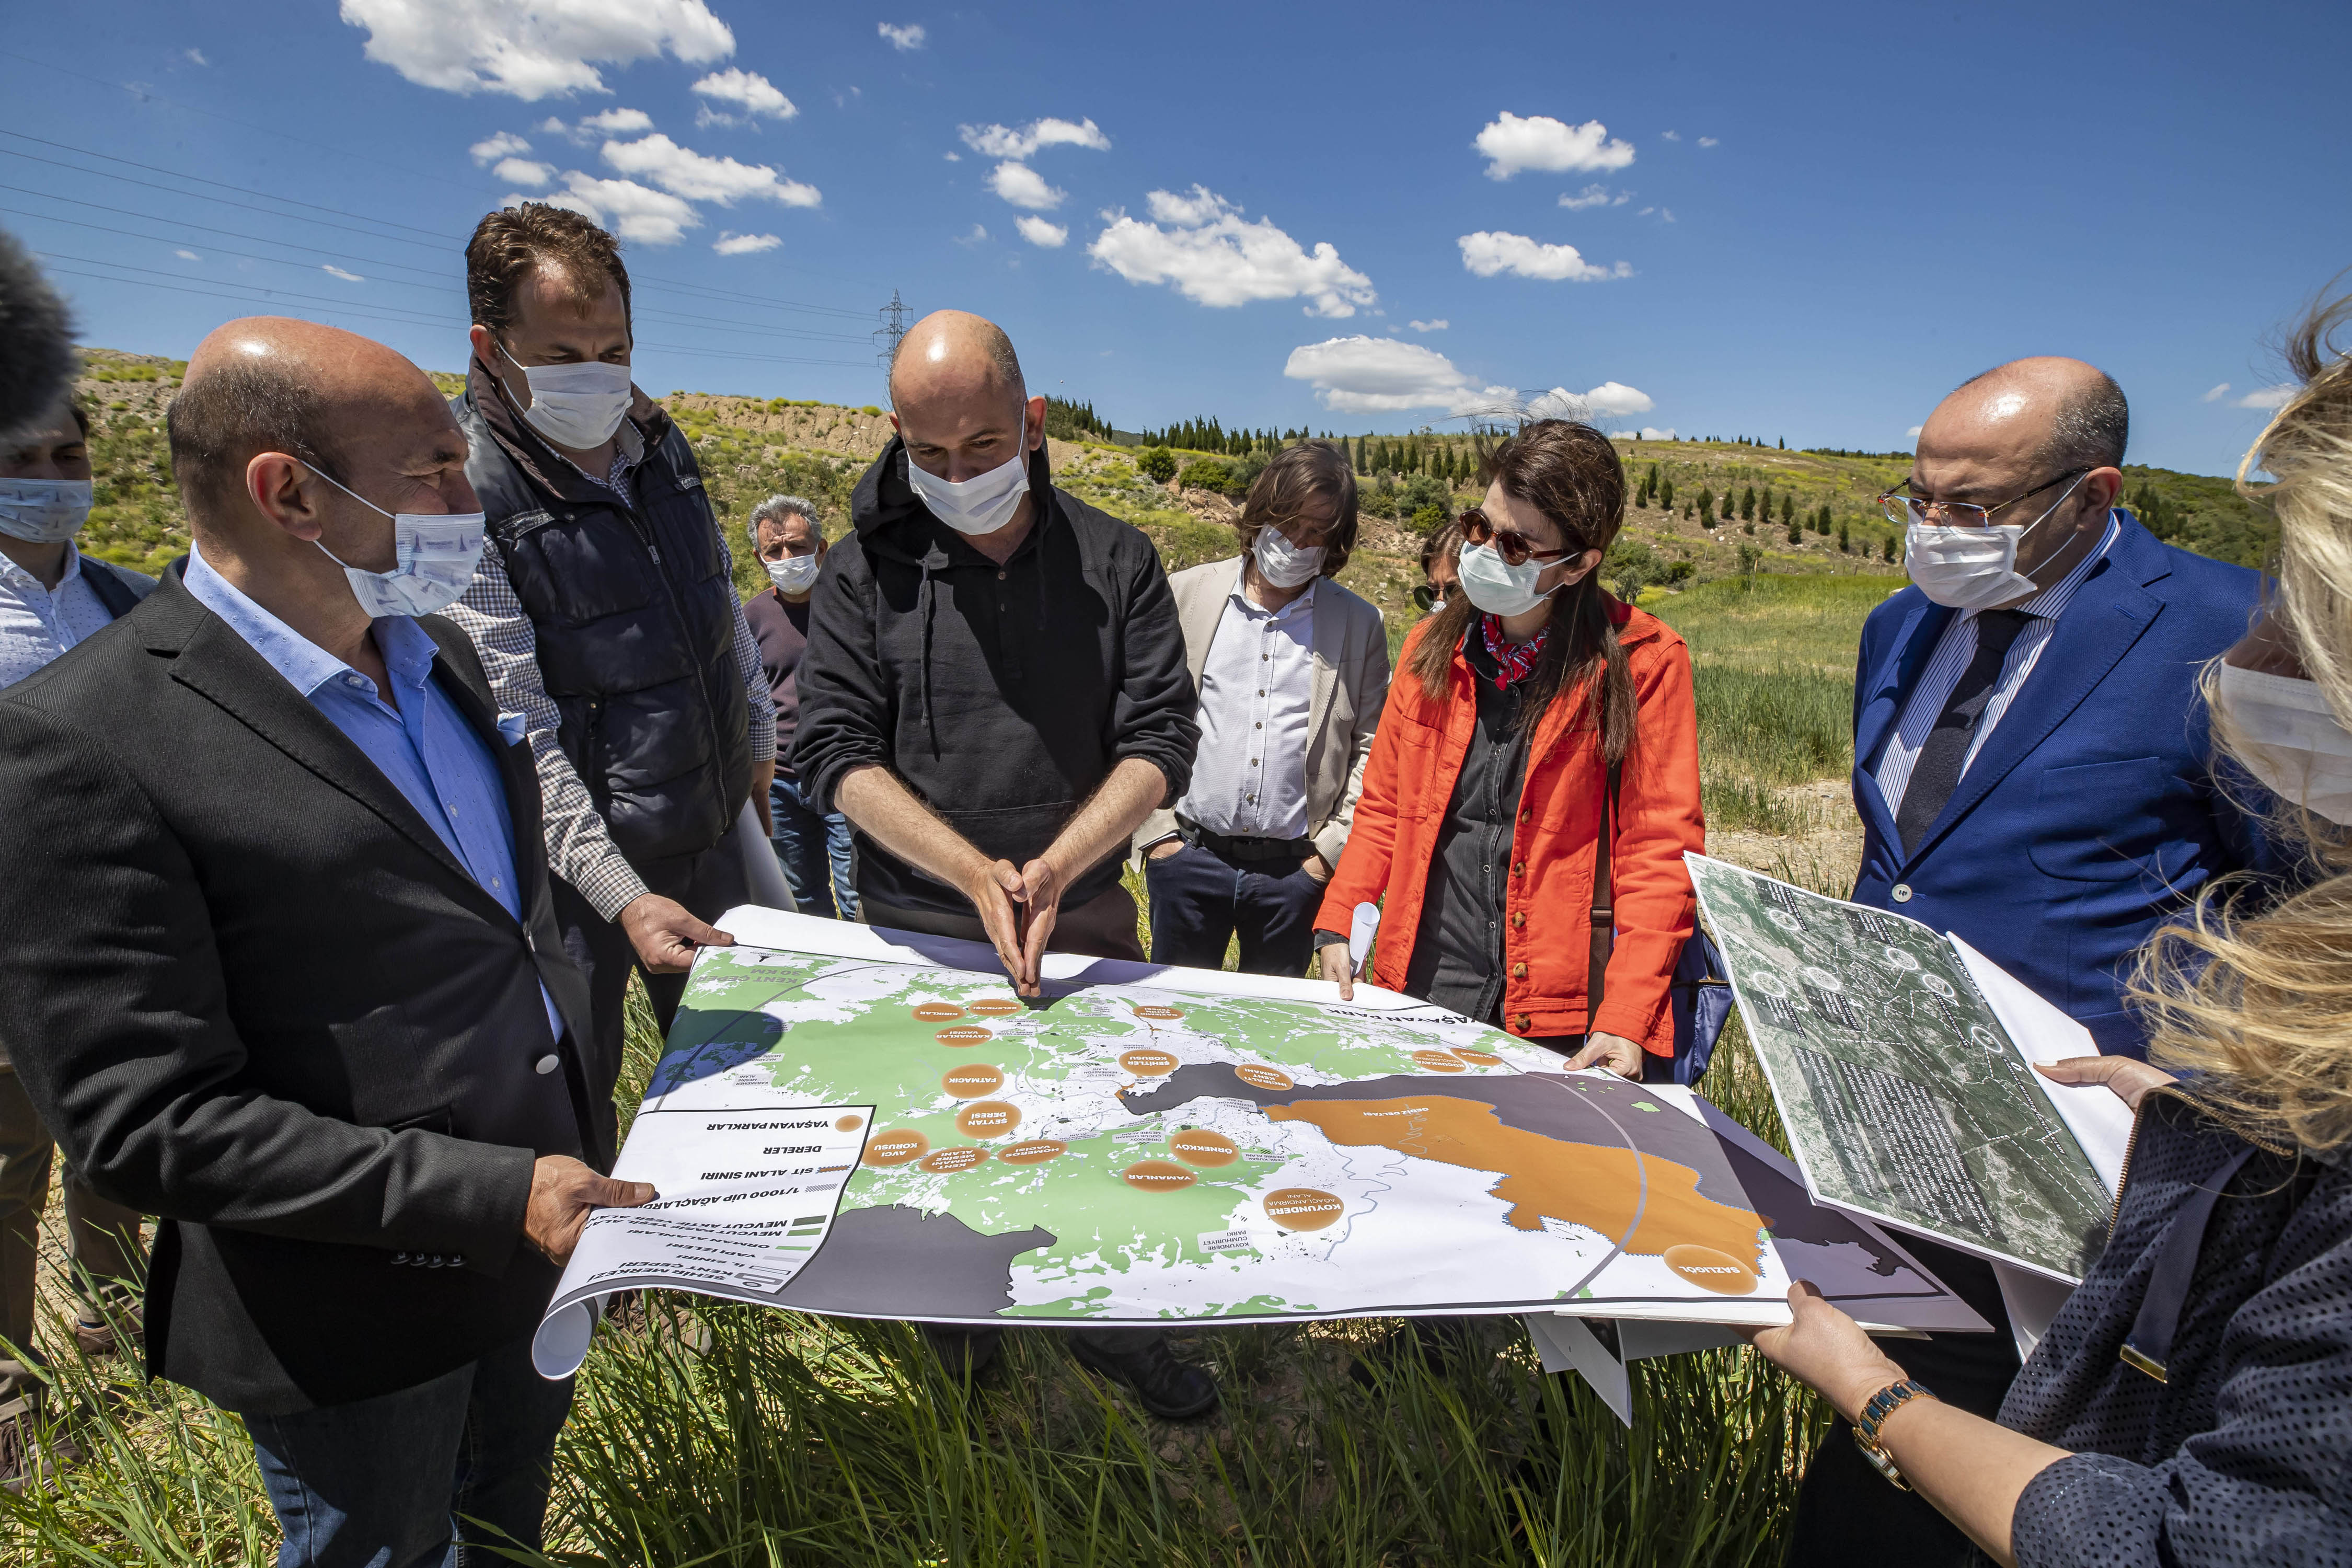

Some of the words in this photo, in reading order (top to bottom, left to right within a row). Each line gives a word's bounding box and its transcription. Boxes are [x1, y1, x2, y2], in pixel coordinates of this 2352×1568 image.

[1791, 890, 1806, 898] 1
[1883, 917, 1900, 928] 2
[1790, 1001, 1809, 1011] 3
[1848, 998, 1865, 1009] 4
[1942, 995, 1960, 1007] 7
[1326, 1009, 1381, 1020] PARK
[1415, 1060, 1465, 1069] KÜÇÜKKAYA
[2010, 1062, 2028, 1074] 6
[1244, 1067, 1280, 1077] ORMANI
[1815, 1053, 1828, 1074] Odaklar
[1825, 1075, 1838, 1098] arasında
[1834, 1099, 1847, 1119] sonsuz
[1839, 1060, 1851, 1075] kendi
[1847, 1076, 1857, 1092] idame
[1854, 1094, 1872, 1125] edebilmeli.
[967, 1117, 1008, 1126] ŞEYTAN
[1849, 1063, 1866, 1092] topluluklar
[1863, 1093, 1882, 1129] üniversiteler
[1883, 1139, 1896, 1162] okullar
[1893, 1162, 1901, 1171] ile
[706, 1122, 768, 1131] PARKLAR
[769, 1120, 829, 1129] YAŞAYAN
[1805, 1050, 1824, 1086] deneyimleme,
[1844, 1148, 1861, 1172] gözlem
[1857, 1173, 1872, 1196] rotaları
[1877, 1071, 1896, 1098] gelişmeli.
[1903, 1123, 1920, 1154] etkinlikler
[1921, 1165, 1942, 1197] büyümeyi
[763, 1145, 822, 1155] DERELER
[873, 1142, 918, 1151] KORUSU
[1175, 1144, 1233, 1155] ÖRNEKKÖY
[1863, 1074, 1877, 1095] kültürel
[1888, 1132, 1898, 1145] kent
[1899, 1155, 1910, 1171] kırda
[1905, 1172, 1928, 1207] yaşayanlar
[1925, 1208, 1933, 1217] ile
[1869, 1069, 1890, 1103] desteklemeli
[1890, 1114, 1905, 1140] noktadan
[1902, 1142, 1913, 1159] sonra
[1908, 1159, 1926, 1186] yaşayan
[1921, 1186, 1935, 1202] park
[1931, 1203, 1946, 1222] doğal
[1904, 1088, 1918, 1111] kulüpler
[1936, 1157, 1951, 1180] birlikte
[1945, 1180, 1963, 1205] yaşama
[1908, 1081, 1920, 1096] narak
[1916, 1098, 1930, 1118] işlevler
[1944, 1156, 1961, 1182] zamanla
[1958, 1184, 1966, 1192] bu
[1963, 1193, 1980, 1220] odakları
[936, 1154, 976, 1162] MESİRE
[1005, 1147, 1060, 1158] HOMEROS
[1918, 1086, 1933, 1107] Yaşayan
[1928, 1108, 1940, 1121] park
[1937, 1122, 1952, 1146] odakları
[1950, 1148, 1968, 1179] belirlenen
[1971, 1194, 1980, 1203] ile
[1977, 1204, 1992, 1228] tasarla-
[931, 1158, 976, 1166] ORMANI
[1903, 1105, 1918, 1127] Yaşayan
[1914, 1129, 1922, 1138] bir
[1919, 1139, 1930, 1154] canlı
[1925, 1154, 1938, 1168] gibi
[1933, 1169, 1949, 1191] sürekli
[1944, 1193, 1962, 1221] büyüyüp
[700, 1172, 743, 1180] SINIRI
[744, 1169, 788, 1179] ALANI
[750, 1186, 799, 1198] 1/1000
[1268, 1204, 1341, 1215] KOYUNDERE
[626, 1219, 667, 1228] YEŞİL
[633, 1215, 673, 1224] YEŞİL
[727, 1220, 788, 1229] MEVCUT
[627, 1229, 709, 1240] ALANLARI
[710, 1238, 770, 1249] ORMAN
[1202, 1236, 1249, 1246] CUMHURİYET
[1207, 1242, 1250, 1251] KOYUNDERE
[665, 1243, 719, 1253] İZLERİ
[676, 1254, 728, 1264] SINIRI
[618, 1261, 684, 1273] ÇEPERİ
[685, 1265, 733, 1276] KENT
[1677, 1265, 1740, 1274] SAZLIGÖL
[586, 1267, 670, 1283] MERKEZİ
[672, 1269, 726, 1281] ŞEHİR
